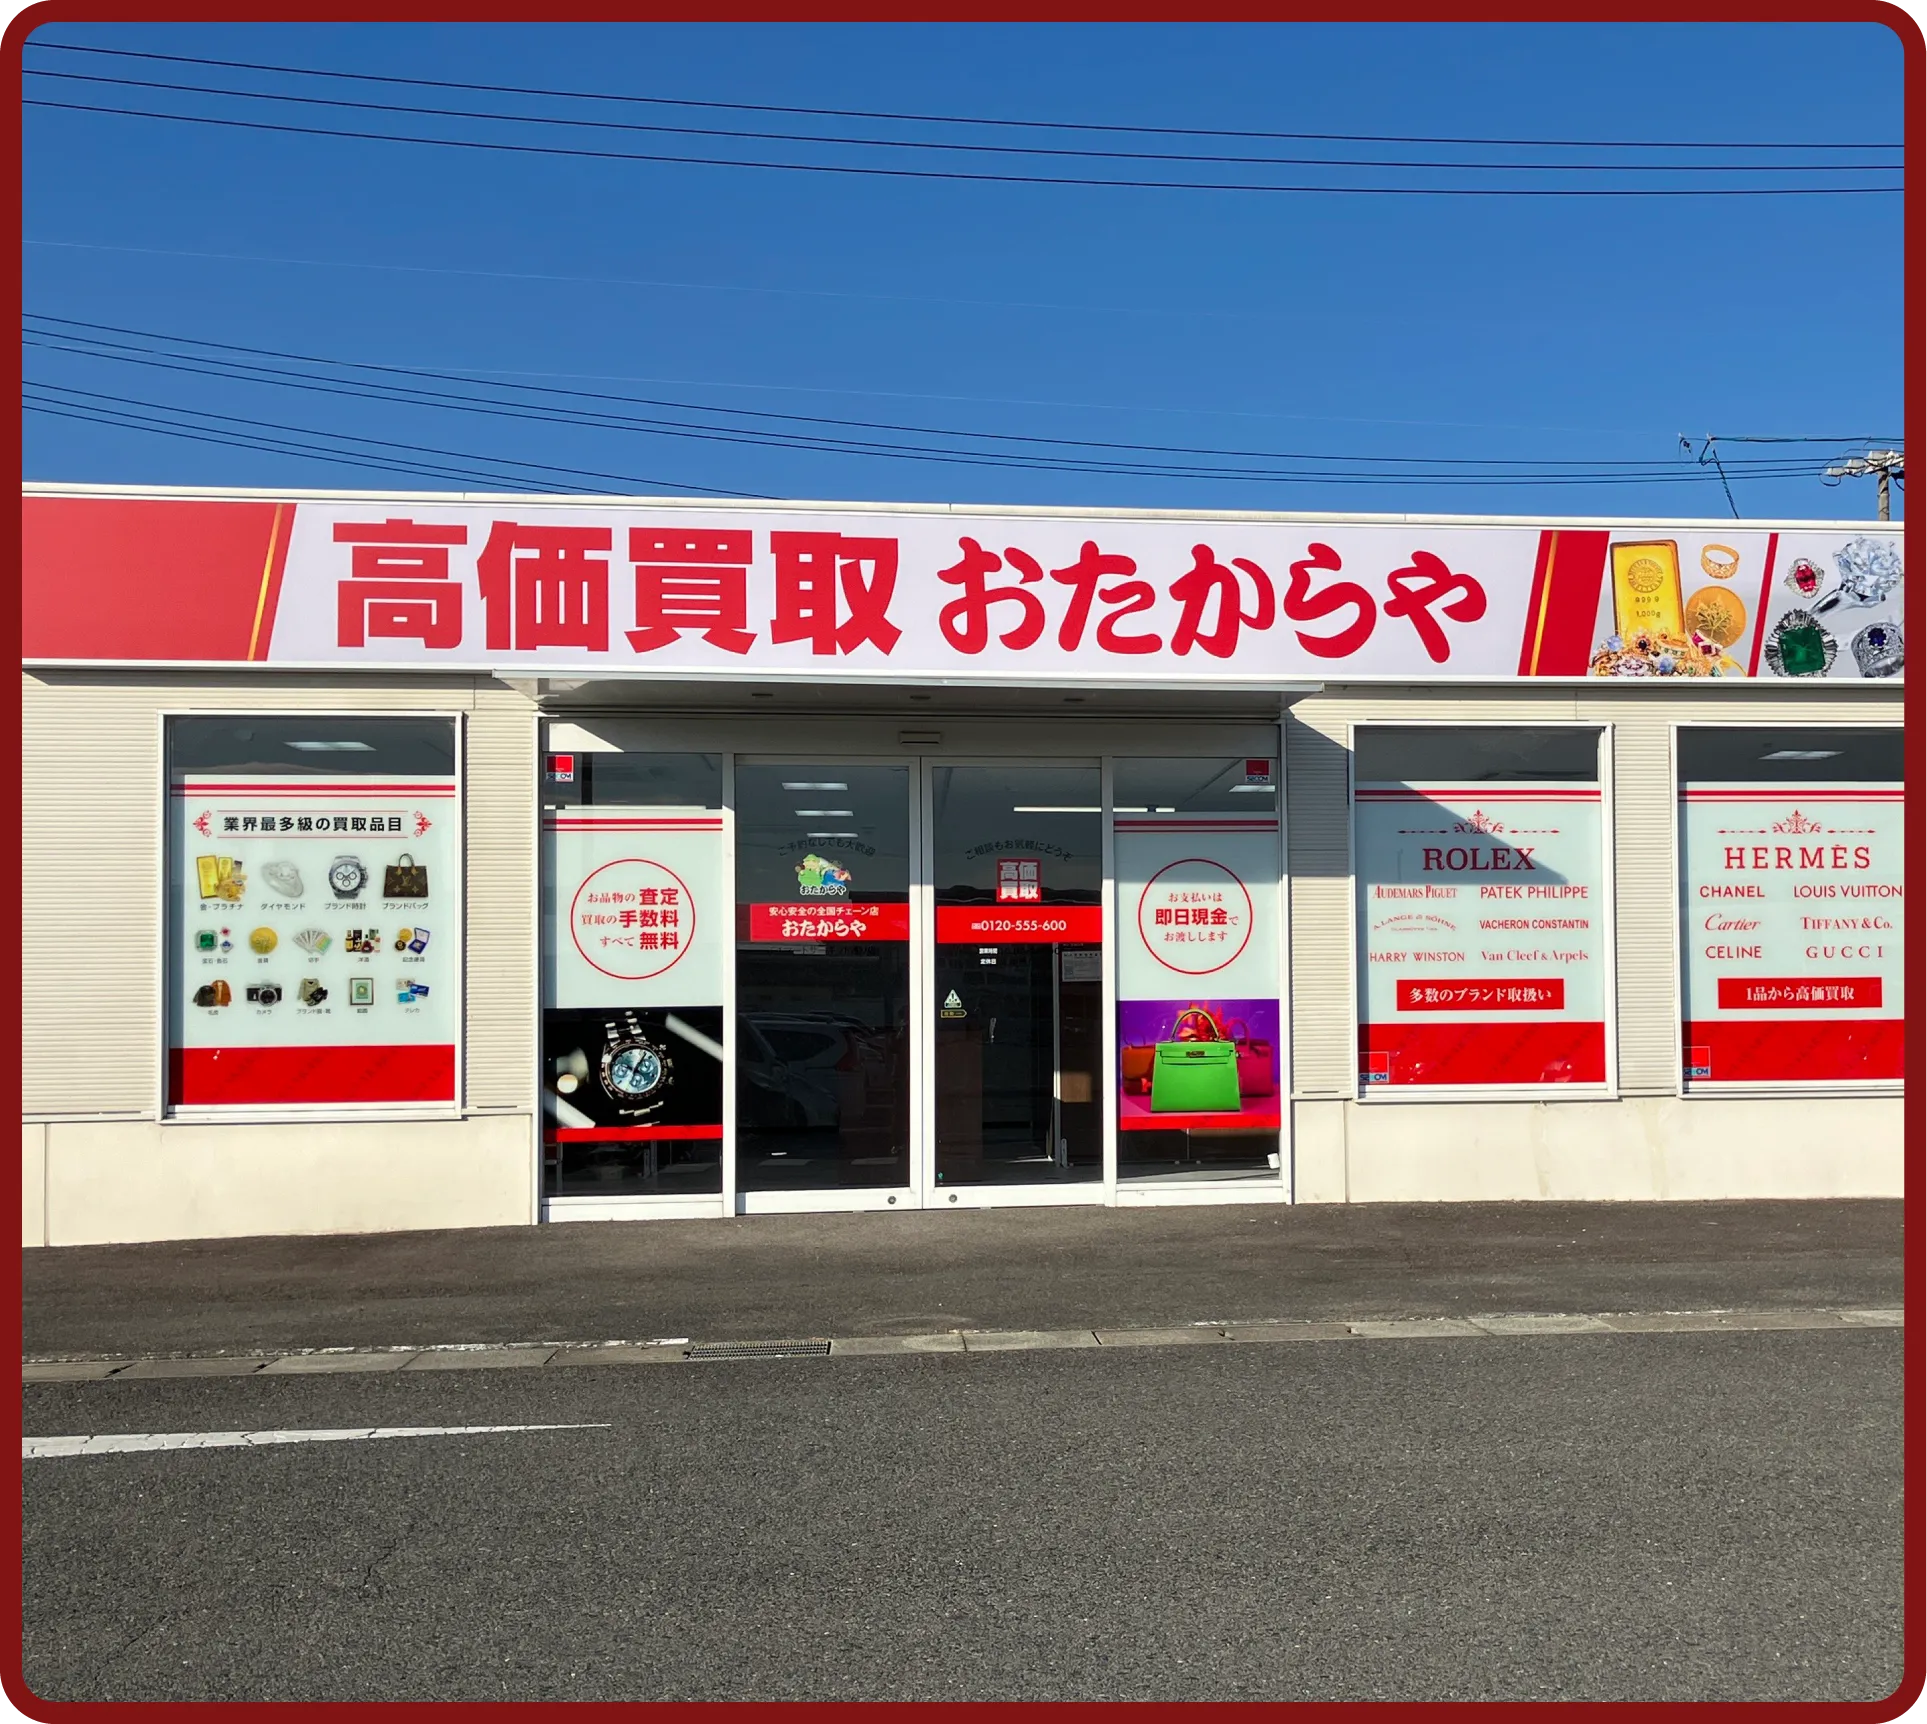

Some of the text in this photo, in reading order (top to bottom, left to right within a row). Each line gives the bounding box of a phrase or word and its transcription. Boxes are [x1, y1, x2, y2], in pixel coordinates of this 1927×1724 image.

[334, 519, 1487, 663] 高価買取 おたからや
[223, 816, 403, 832] 業界最多級の買取品目
[1422, 847, 1537, 871] ROLEX
[1724, 844, 1871, 870] HERMÈS
[1000, 862, 1038, 880] 高価
[587, 888, 679, 905] お品物の査定
[799, 885, 847, 896] おたからや
[1000, 881, 1038, 900] 買取
[1168, 892, 1223, 903] お支払いは
[1373, 885, 1458, 899] AUDEMARS PIGUET
[1480, 886, 1589, 899] PATEK PHILIPPE
[1699, 885, 1765, 898] CHANEL
[1794, 885, 1903, 898] LOUIS VUITTON
[260, 903, 306, 911] ダイヤモンド
[324, 902, 367, 910] ブランド時計
[382, 902, 429, 910] ブランドバッグ
[769, 906, 879, 916] 安心安全の全国チェーン店
[581, 910, 679, 928] 買取の手数料
[1155, 908, 1239, 926] 即日現金で
[1704, 913, 1761, 931] Cartier
[1800, 916, 1859, 930] TIFFANY
[782, 919, 867, 938] おたからや
[981, 920, 1067, 931] 0120-555-600
[1480, 919, 1589, 930] VACHERON CONSTANTIN
[600, 932, 679, 950] すべて無料
[1163, 931, 1228, 942] お渡しします
[1370, 952, 1465, 962] HARRY WINSTON
[1481, 949, 1589, 964] Van Cleef & Arpels
[1705, 946, 1762, 959] CELINE
[1806, 945, 1884, 958] GUCCI
[1410, 987, 1552, 1004] 多数のブランド取扱い
[1746, 985, 1855, 1001] 1品から高価買取
